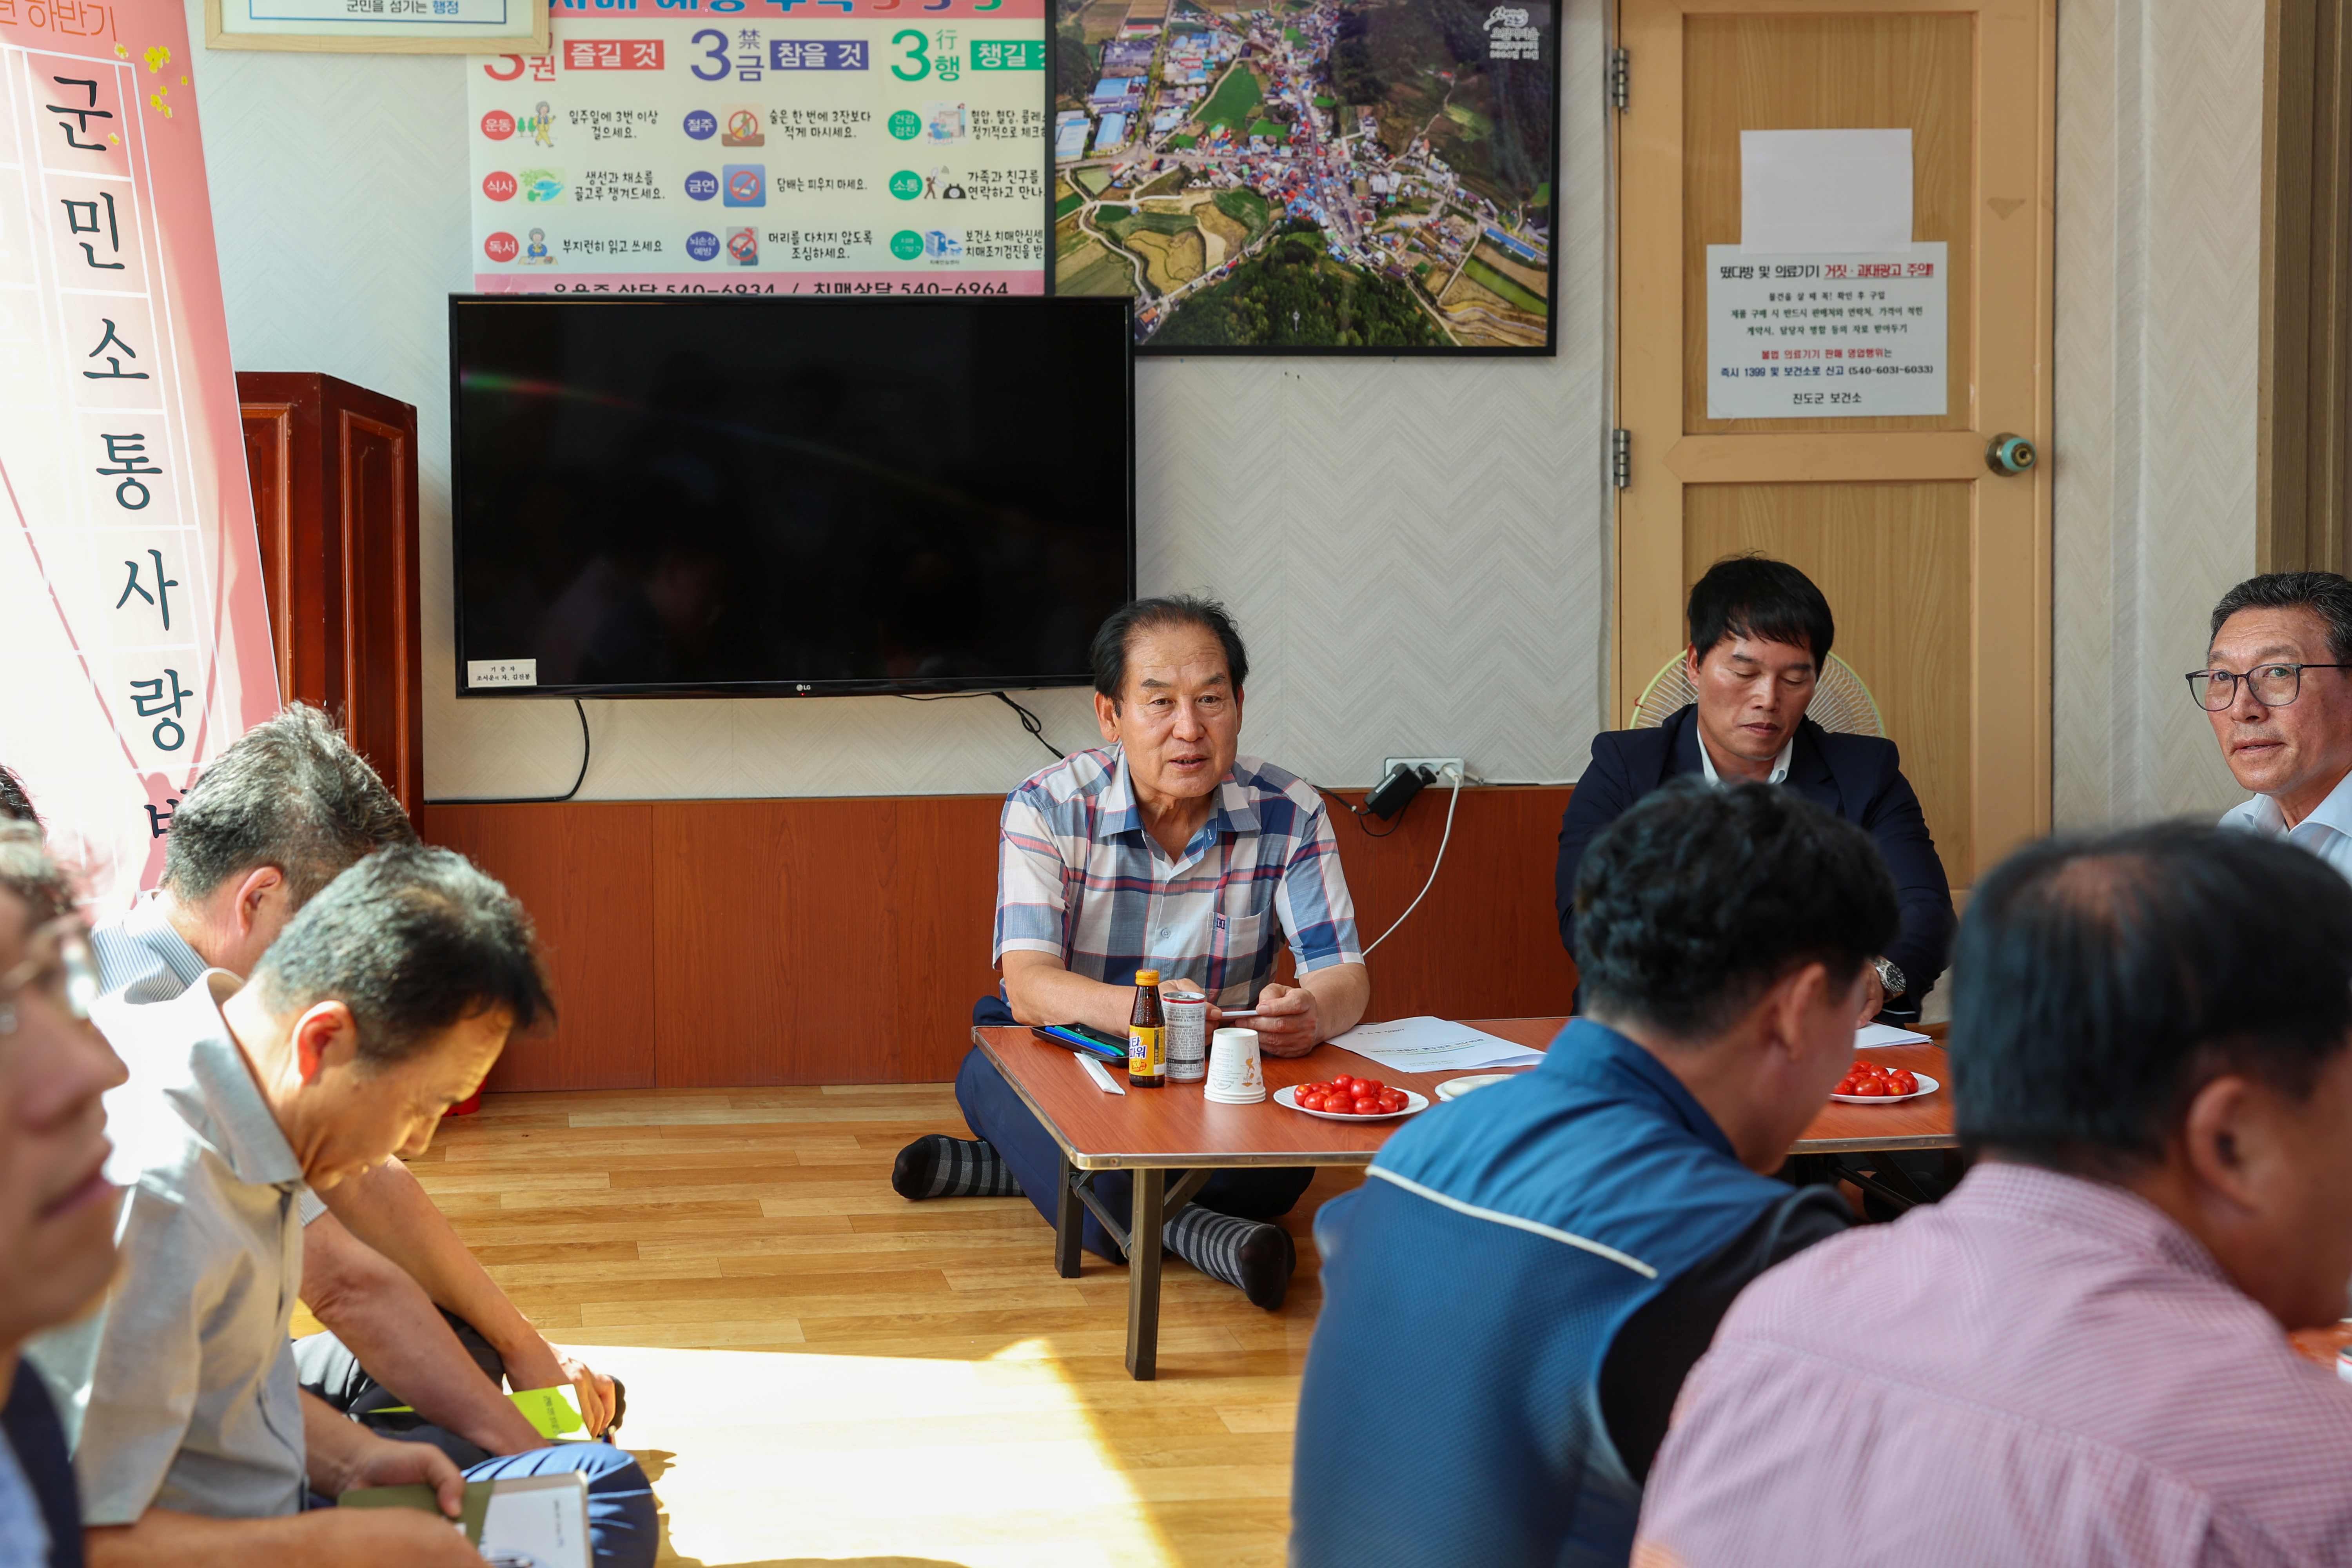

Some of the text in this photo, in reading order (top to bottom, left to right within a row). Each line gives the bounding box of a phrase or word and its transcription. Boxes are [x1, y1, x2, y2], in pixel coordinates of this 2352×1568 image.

[433, 1, 459, 14] 행정
[25, 0, 116, 41] 하반기
[571, 43, 622, 67] 즐길
[633, 43, 657, 67] 것
[778, 43, 827, 67] 참을
[838, 43, 861, 67] 것
[978, 43, 1026, 68] 챙길
[569, 110, 659, 124] 일주일에 3번 이상
[769, 110, 871, 124] 술은 한 번에 3잔보다
[485, 119, 512, 133] 운동
[687, 118, 714, 133] 절주
[784, 126, 857, 139] 적게 마시세요.
[592, 126, 637, 140] 걸으세요.
[973, 126, 1017, 140] 정기적으로
[585, 170, 653, 186] 생선과 채소를
[967, 169, 1039, 184] 가족과 친구를
[486, 181, 514, 193] 식사
[688, 180, 715, 193] 금연
[777, 178, 867, 192] 담배는 피우지 마세요.
[893, 180, 919, 192] 소통
[574, 187, 666, 201] 골고루 챙겨드세요.
[967, 185, 1014, 200] 연락하고
[768, 230, 873, 245] 머리를 다치지 않도록
[966, 230, 991, 243] 보건소
[488, 241, 515, 253] 독서
[563, 239, 663, 254] 부지런히 읽고 쓰세요
[966, 244, 1030, 260] 치매조기검진을
[791, 247, 850, 261] 조심하세요.
[1759, 266, 1770, 279] 및
[1775, 265, 1819, 278] 의료기기
[1784, 349, 1820, 359] 의료기기
[1721, 367, 1739, 377] 즉시
[1744, 367, 1766, 377] 1399
[1770, 367, 1779, 377] 및
[1784, 366, 1821, 376] 보건소로
[1826, 365, 1844, 376] 신고
[1793, 392, 1862, 405] 진도군 보건소
[46, 76, 194, 839] 군민소통사랑
